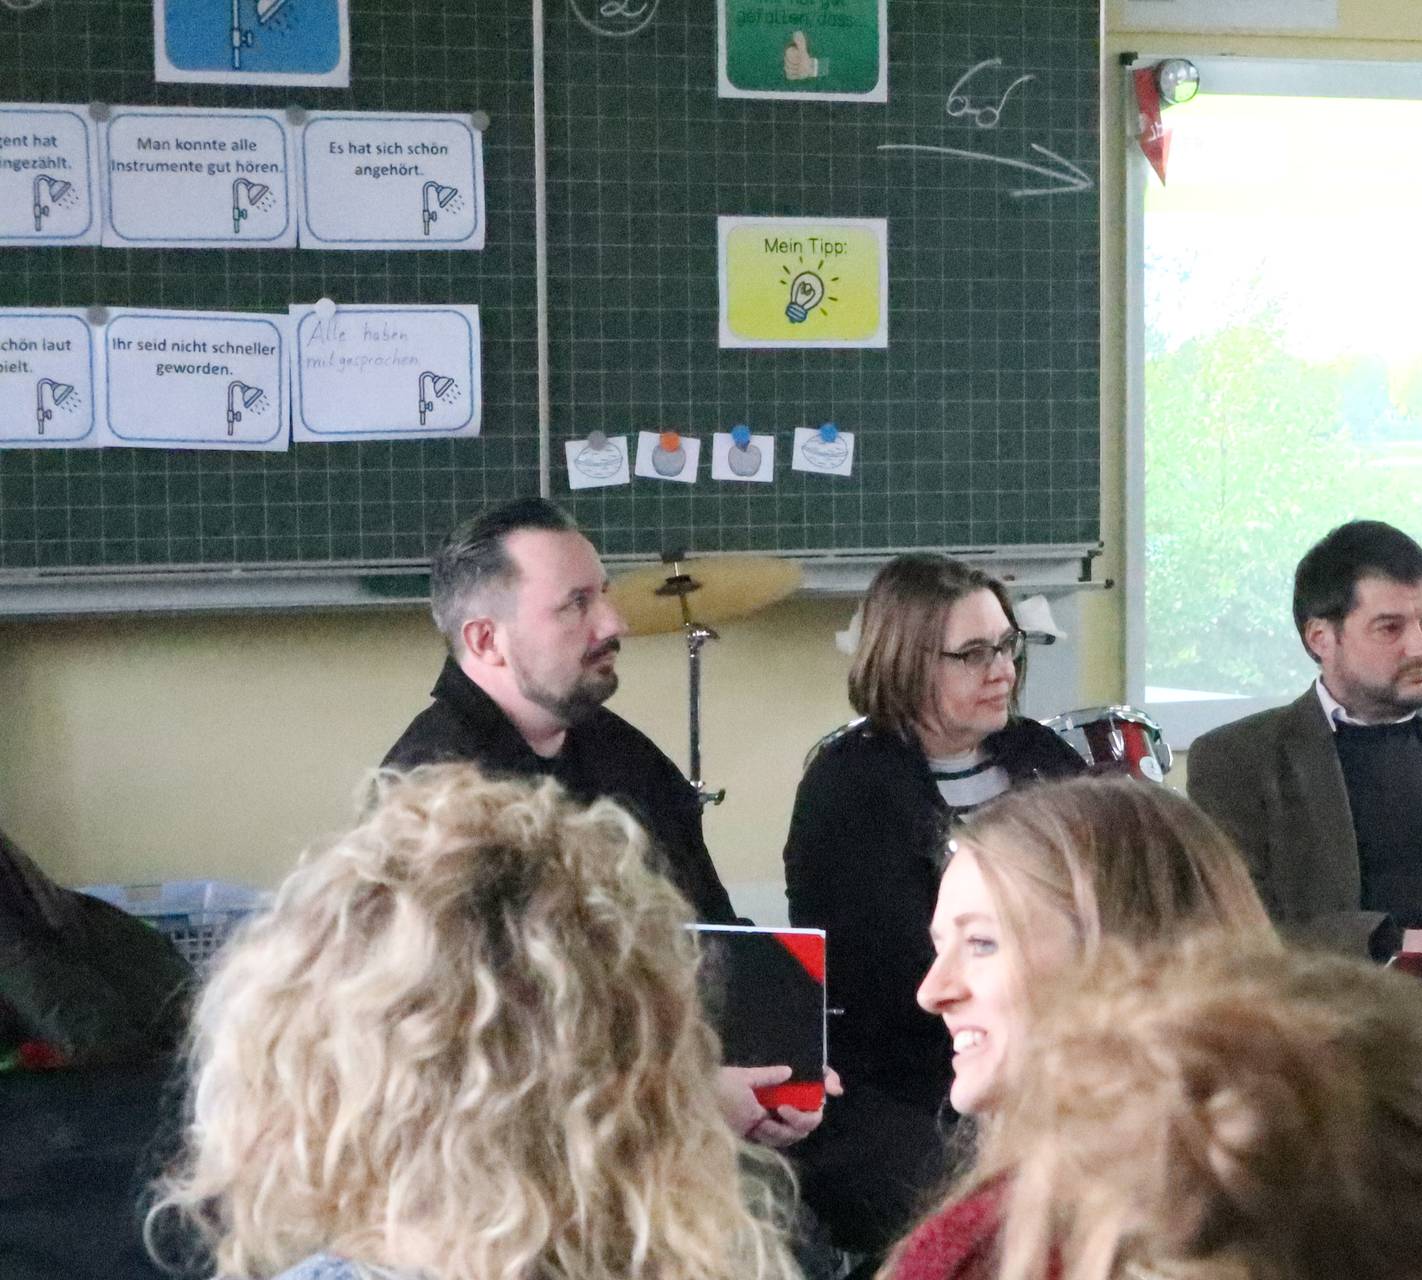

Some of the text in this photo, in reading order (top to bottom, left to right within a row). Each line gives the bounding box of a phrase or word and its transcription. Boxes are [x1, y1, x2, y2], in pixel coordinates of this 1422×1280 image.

[32, 133, 58, 148] hat
[136, 137, 257, 152] Man konnte alle
[329, 141, 448, 155] Es hat sich schön
[111, 159, 283, 175] Instrumente gut hören.
[355, 163, 425, 179] angehört.
[764, 237, 848, 258] Mein Tipp:
[306, 319, 409, 347] Alle haben
[42, 337, 72, 351] laut
[112, 338, 277, 356] Ihr seid nicht schneller
[156, 362, 233, 376] geworden.
